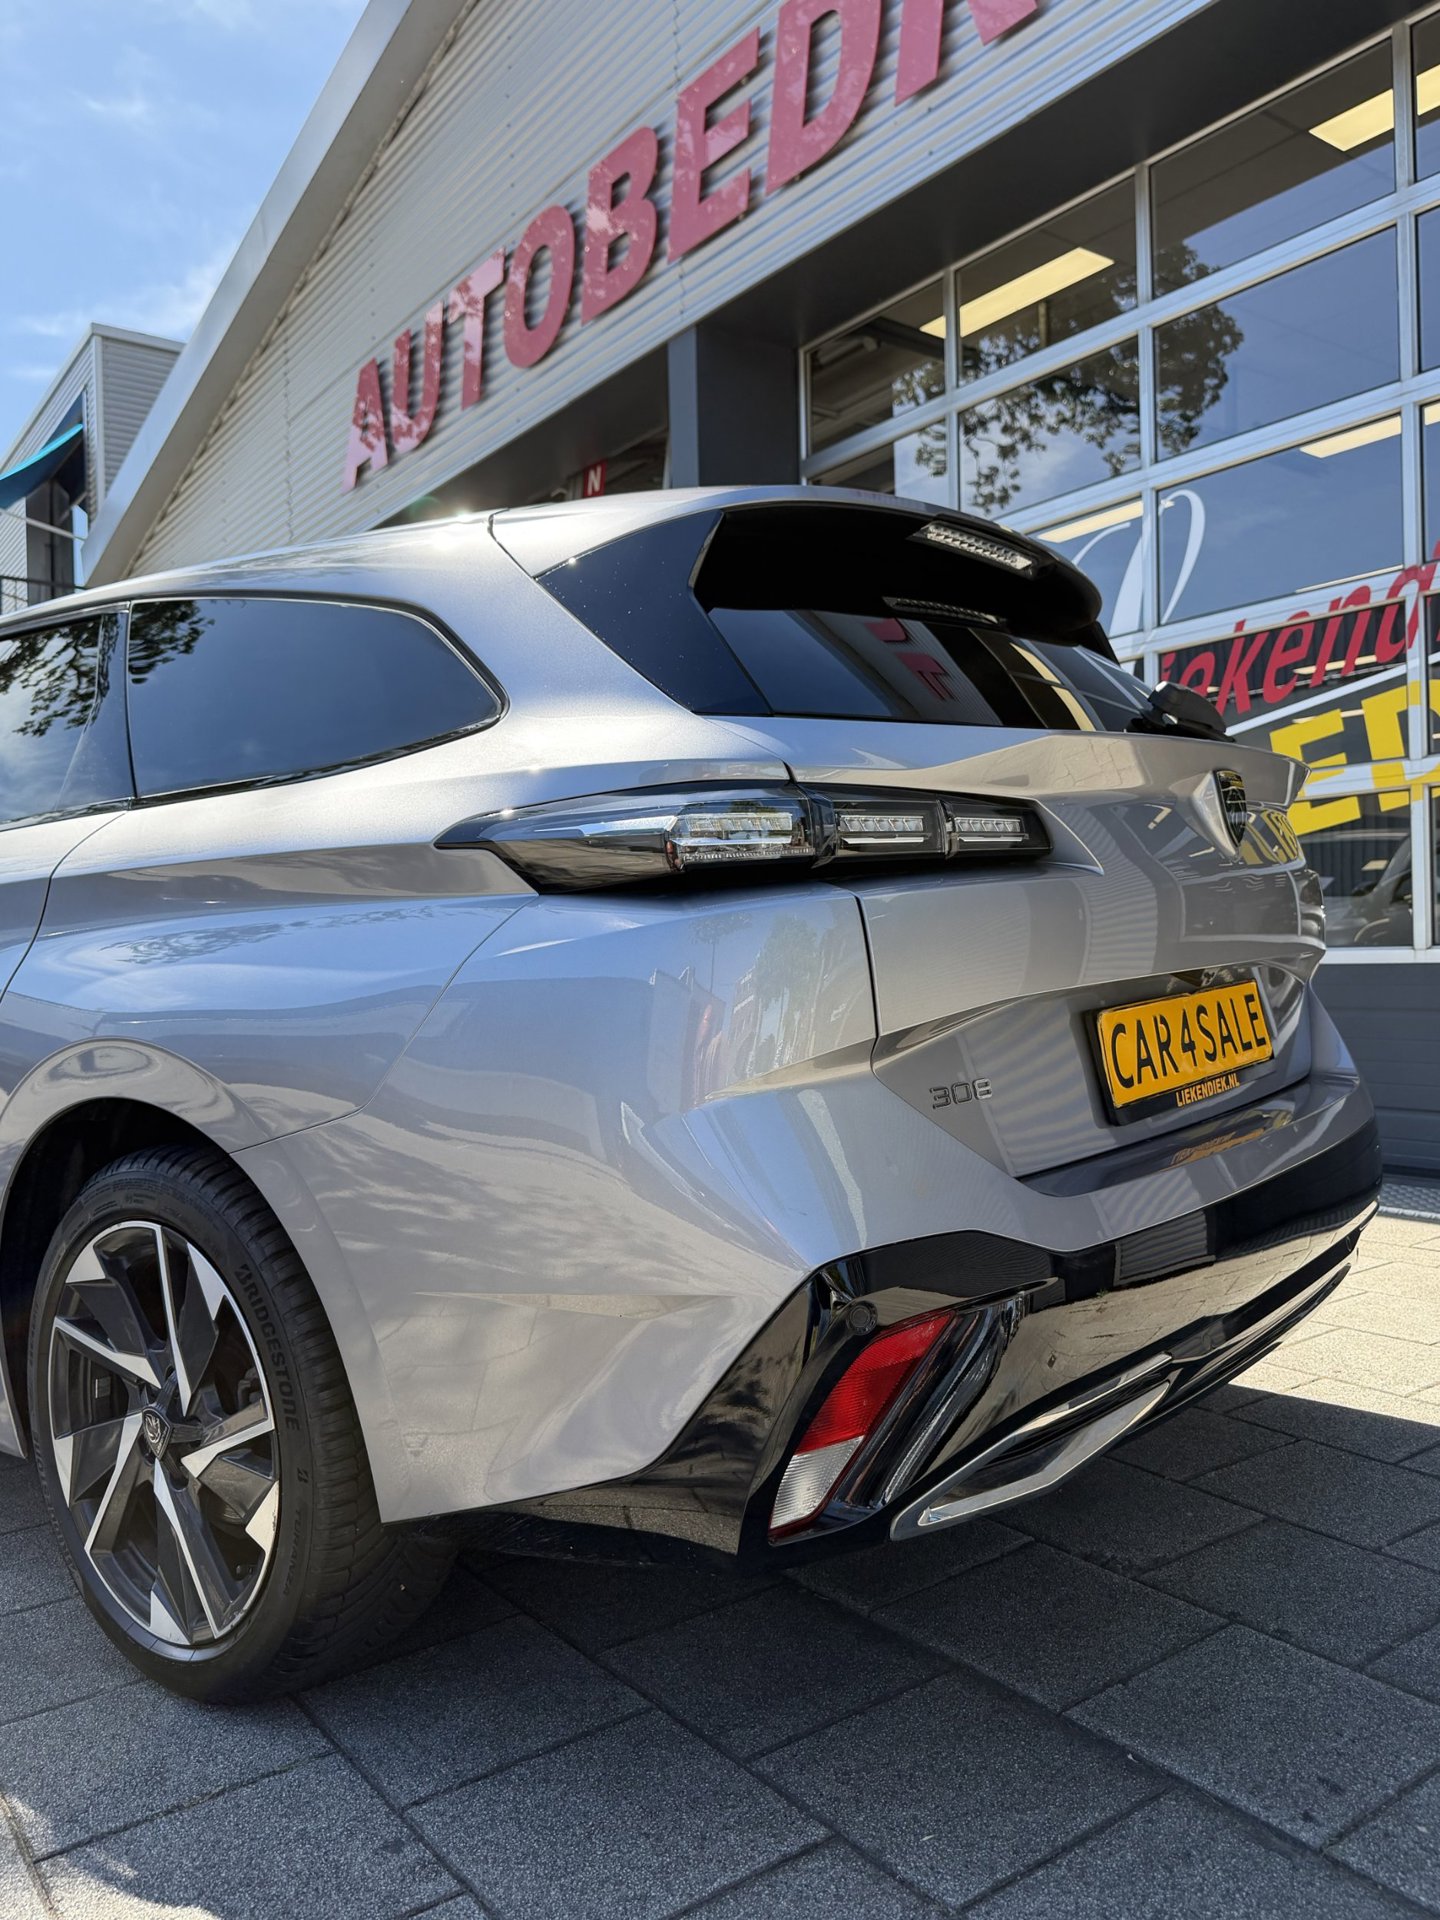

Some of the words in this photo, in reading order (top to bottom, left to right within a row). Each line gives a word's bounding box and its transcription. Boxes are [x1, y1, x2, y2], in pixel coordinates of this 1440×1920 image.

[1111, 993, 1267, 1089] CAR4SALE
[929, 1078, 993, 1110] 308
[1175, 1072, 1240, 1107] LIEKENDIEK.NL
[234, 1263, 300, 1432] BRIDGESTONE
